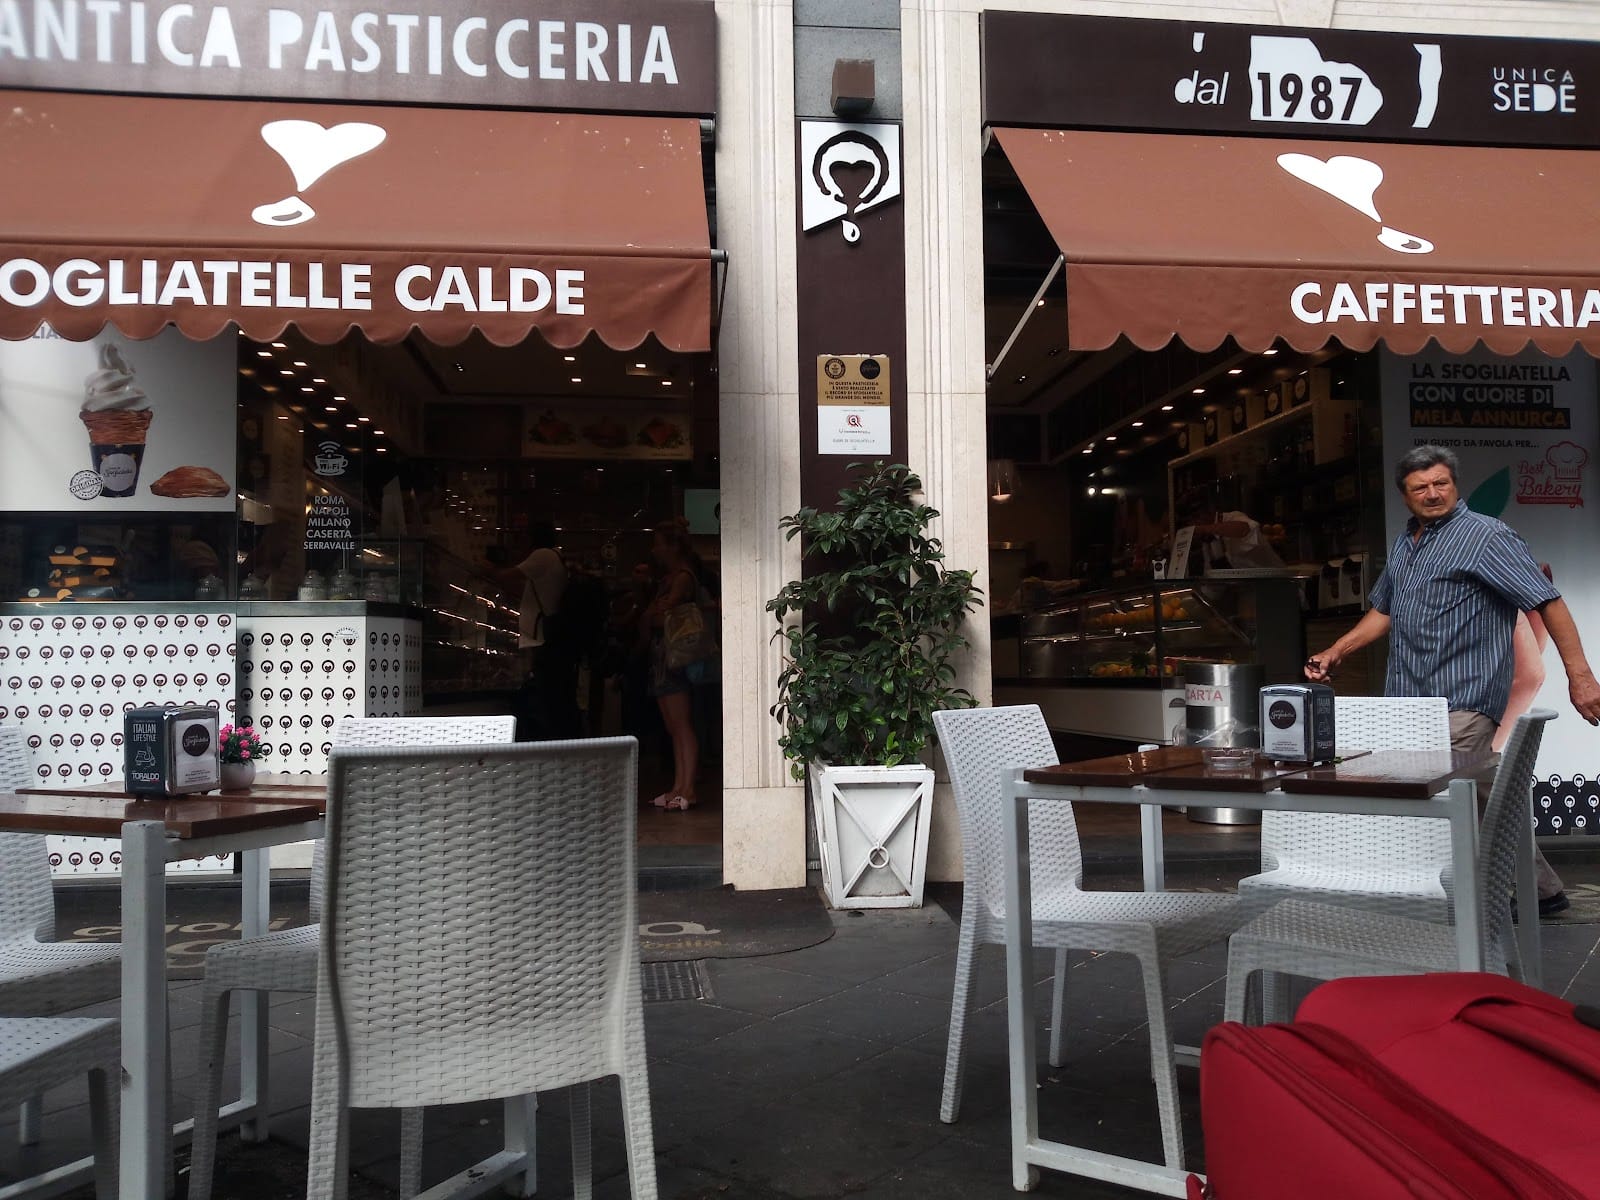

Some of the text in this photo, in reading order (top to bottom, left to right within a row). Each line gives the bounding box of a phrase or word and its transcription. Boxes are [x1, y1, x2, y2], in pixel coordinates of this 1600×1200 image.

[0, 0, 679, 85] ANTICA PASTICCERIA
[1493, 66, 1574, 83] UNICA
[1174, 70, 1363, 121] dal 1987
[1493, 81, 1577, 113] SEDE
[0, 257, 586, 316] OGLIATELLE CALDE
[1290, 282, 1600, 328] CAFFETTERIA
[1412, 363, 1572, 381] LA SFOGLIATELLA
[1412, 386, 1551, 404] CON CUORE DI
[1413, 409, 1568, 427] MELA ANNURCA
[1463, 439, 1476, 447] DA
[1479, 439, 1513, 448] FAVOLA
[1518, 460, 1546, 475] Best
[1519, 476, 1582, 496] Bakery
[314, 495, 345, 505] ROMA
[310, 506, 350, 516] NAPOLI
[308, 518, 351, 527] MILANO
[306, 529, 352, 539] CASERTA
[303, 541, 355, 550] SERRAVALLE
[133, 724, 157, 733] ITALIAN
